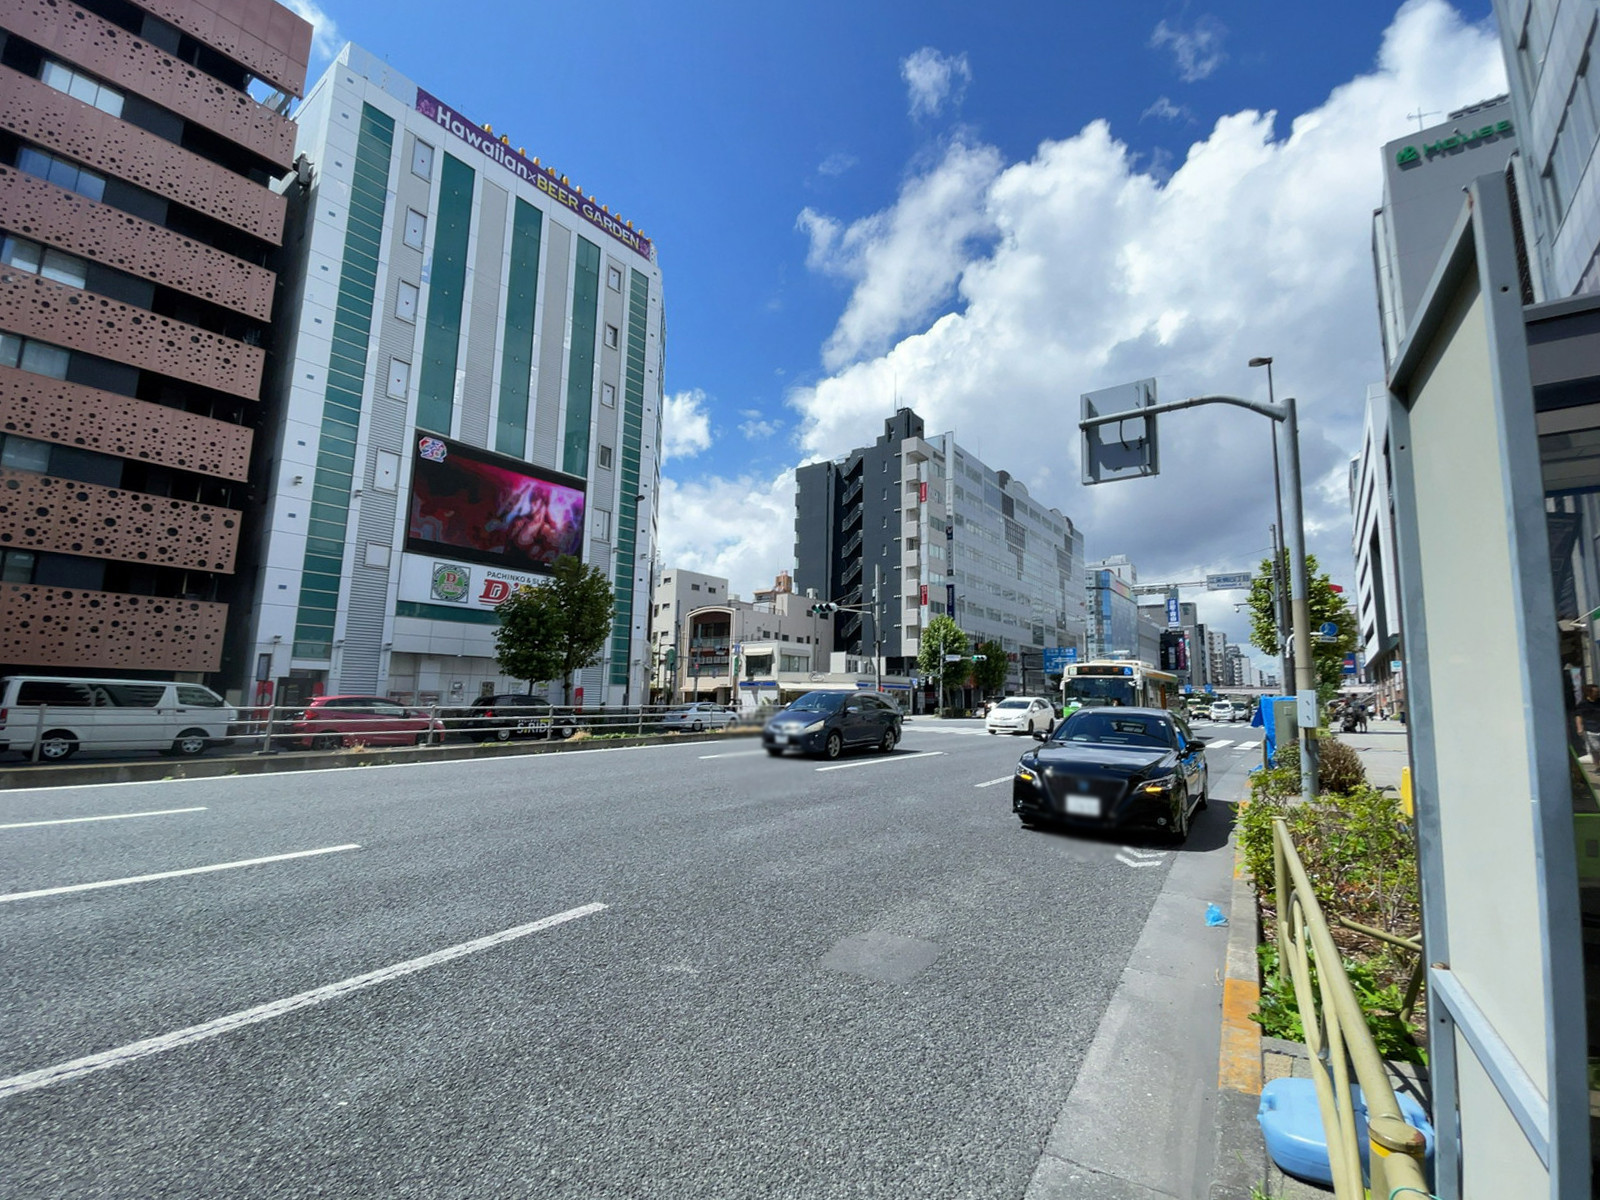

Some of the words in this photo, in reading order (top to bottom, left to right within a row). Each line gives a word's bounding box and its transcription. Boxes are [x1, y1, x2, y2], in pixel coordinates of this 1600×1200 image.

[436, 105, 528, 179] Hawaiian
[536, 173, 579, 211] BEER
[582, 203, 640, 250] GARDEN
[486, 570, 525, 583] PACHINKO
